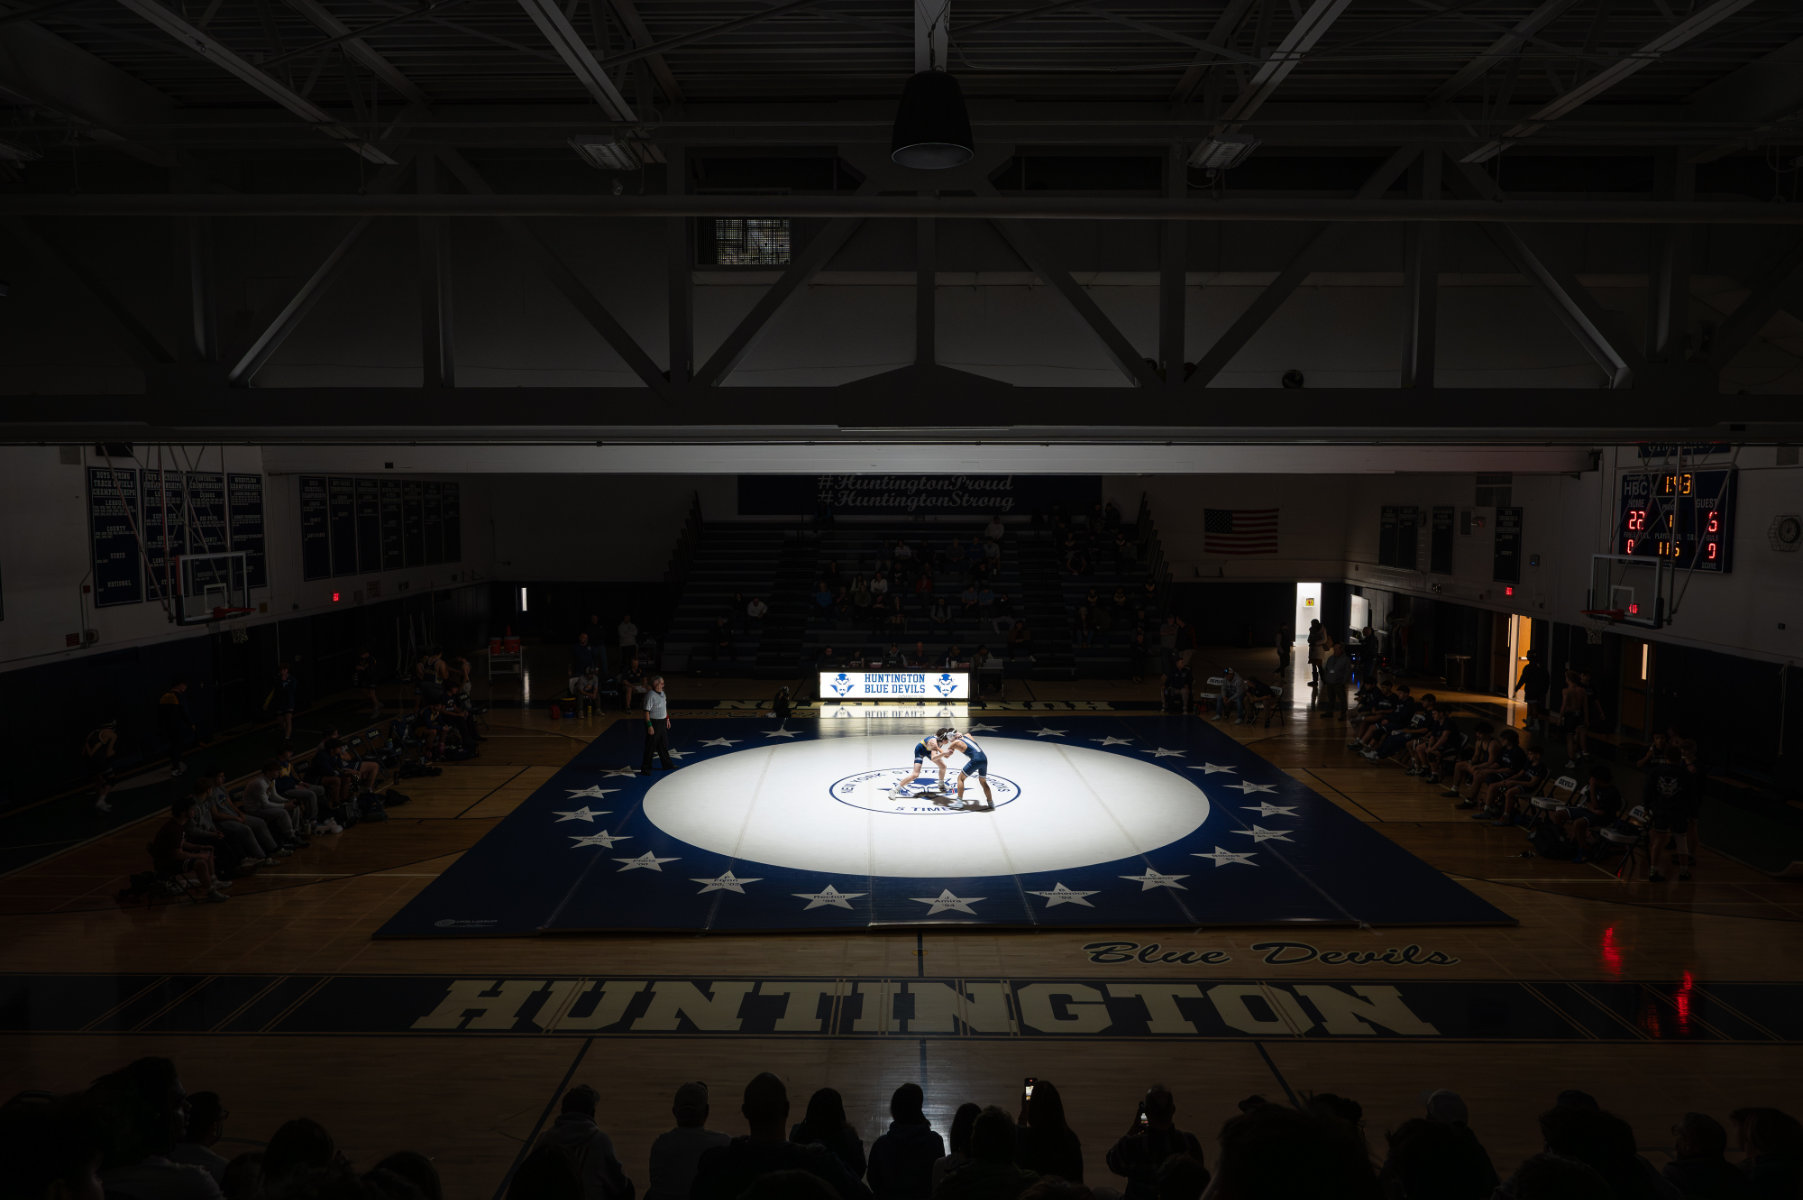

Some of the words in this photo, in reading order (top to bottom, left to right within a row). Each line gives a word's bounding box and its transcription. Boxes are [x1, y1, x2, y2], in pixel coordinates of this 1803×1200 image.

[817, 474, 1014, 494] #HuntingtonProud
[1623, 481, 1648, 496] HBC
[817, 490, 1015, 512] #HuntingtonStrong
[1628, 510, 1646, 530] 22
[864, 673, 926, 683] HUNTINGTON
[864, 684, 889, 694] BLUE
[891, 684, 926, 694] DEVILS
[1085, 941, 1231, 965] Blue
[1249, 942, 1460, 966] Devils
[408, 979, 1441, 1036] HUNTINGTON
